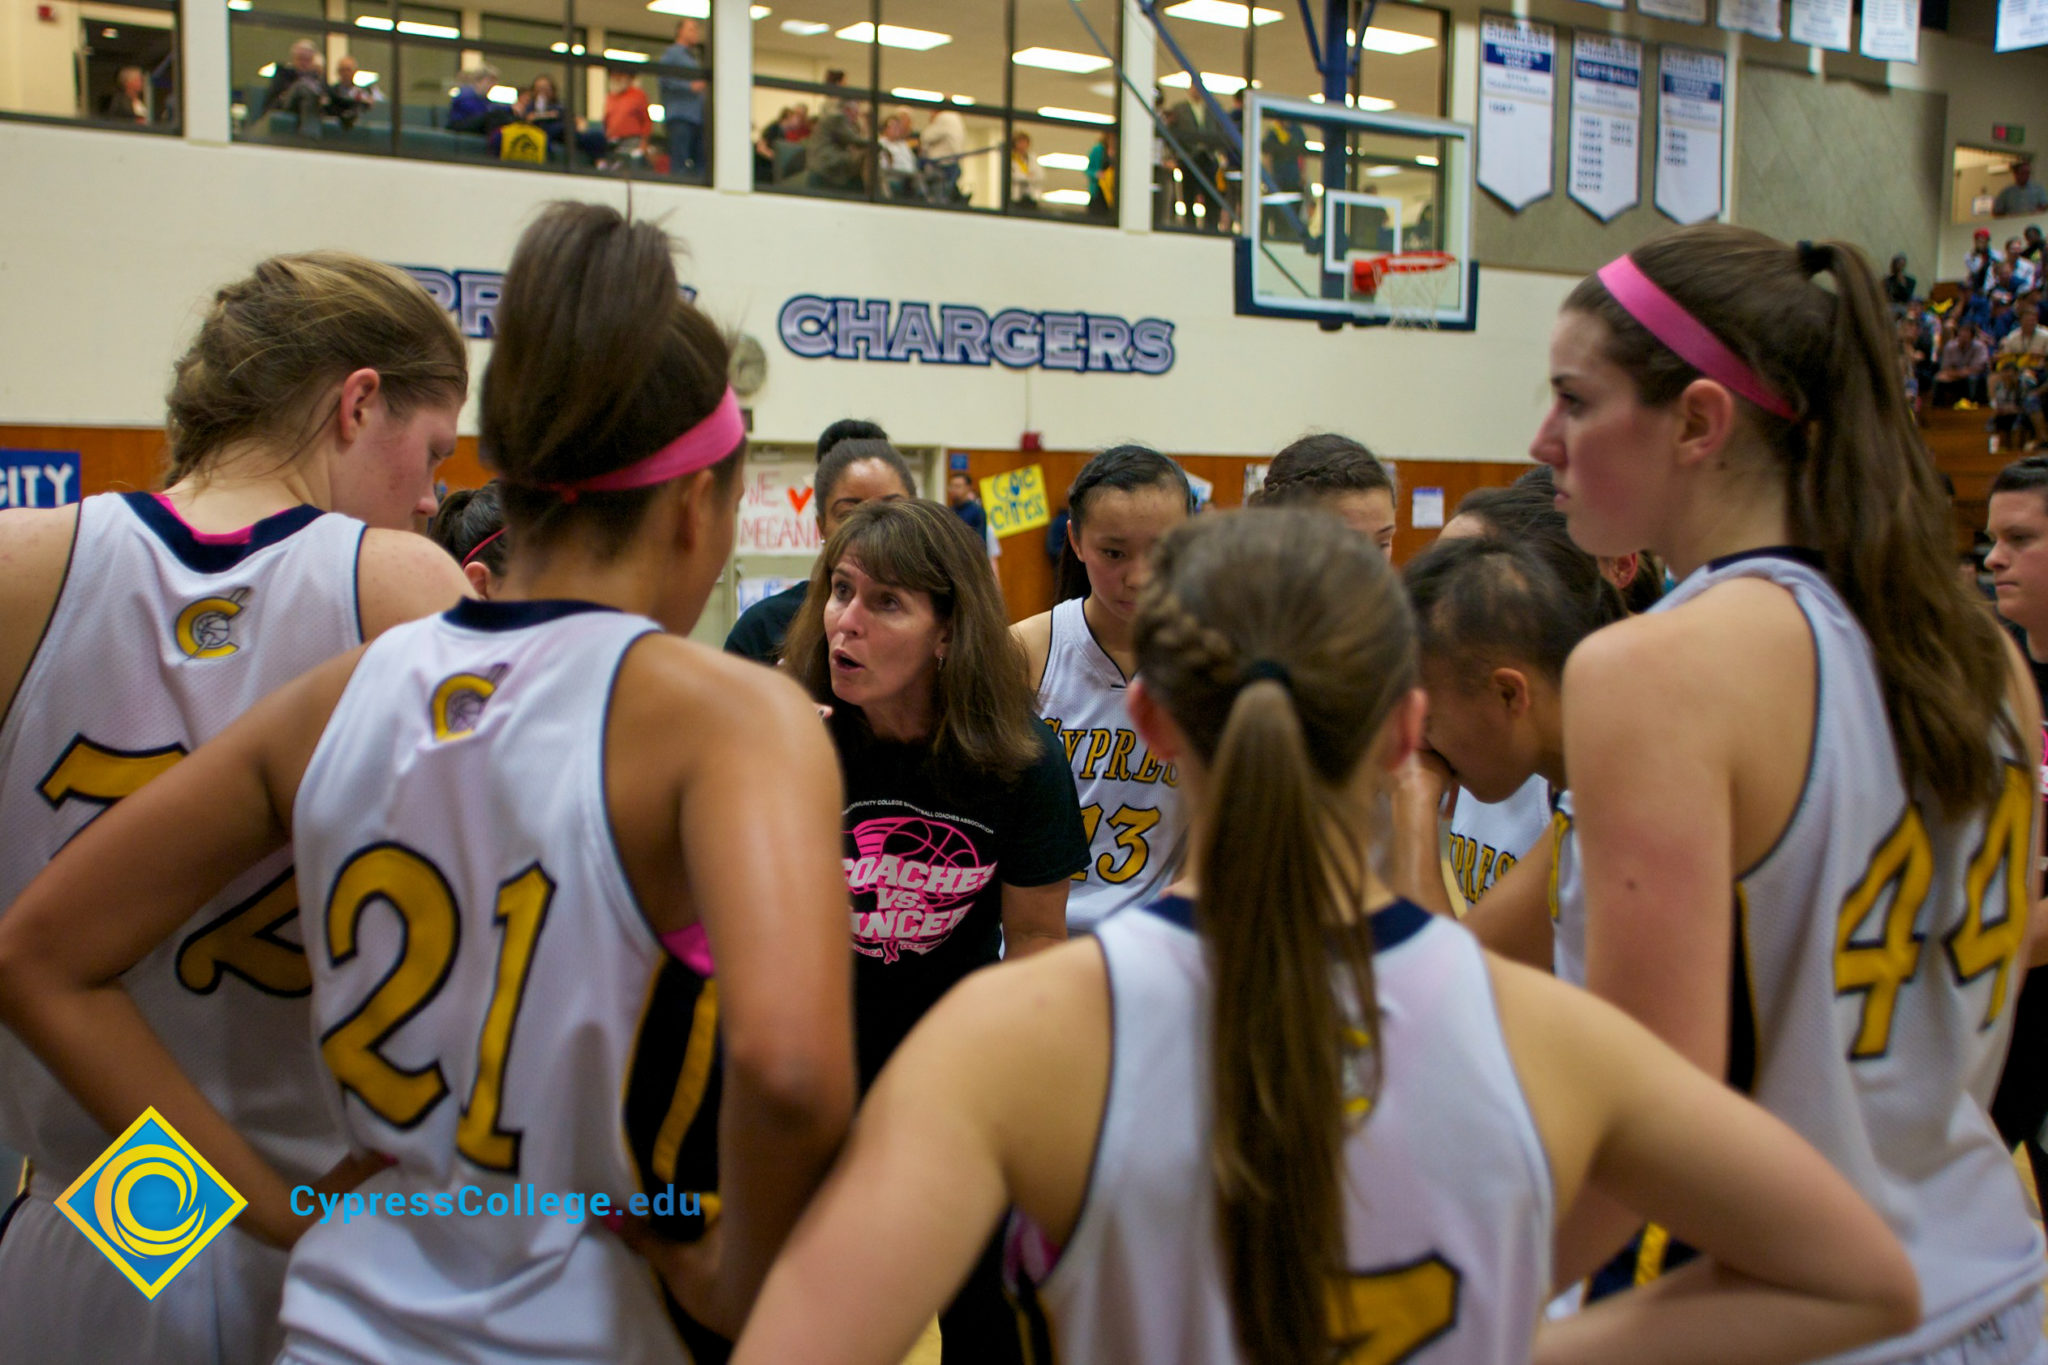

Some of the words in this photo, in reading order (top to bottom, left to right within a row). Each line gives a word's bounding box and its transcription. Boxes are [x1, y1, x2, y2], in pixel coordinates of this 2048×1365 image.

[779, 294, 1176, 376] CHARGERS
[934, 811, 960, 822] COACHES
[960, 817, 994, 835] ASSOCIATION
[877, 887, 926, 910] VS.
[1833, 757, 2034, 1062] 44
[320, 840, 557, 1176] 21
